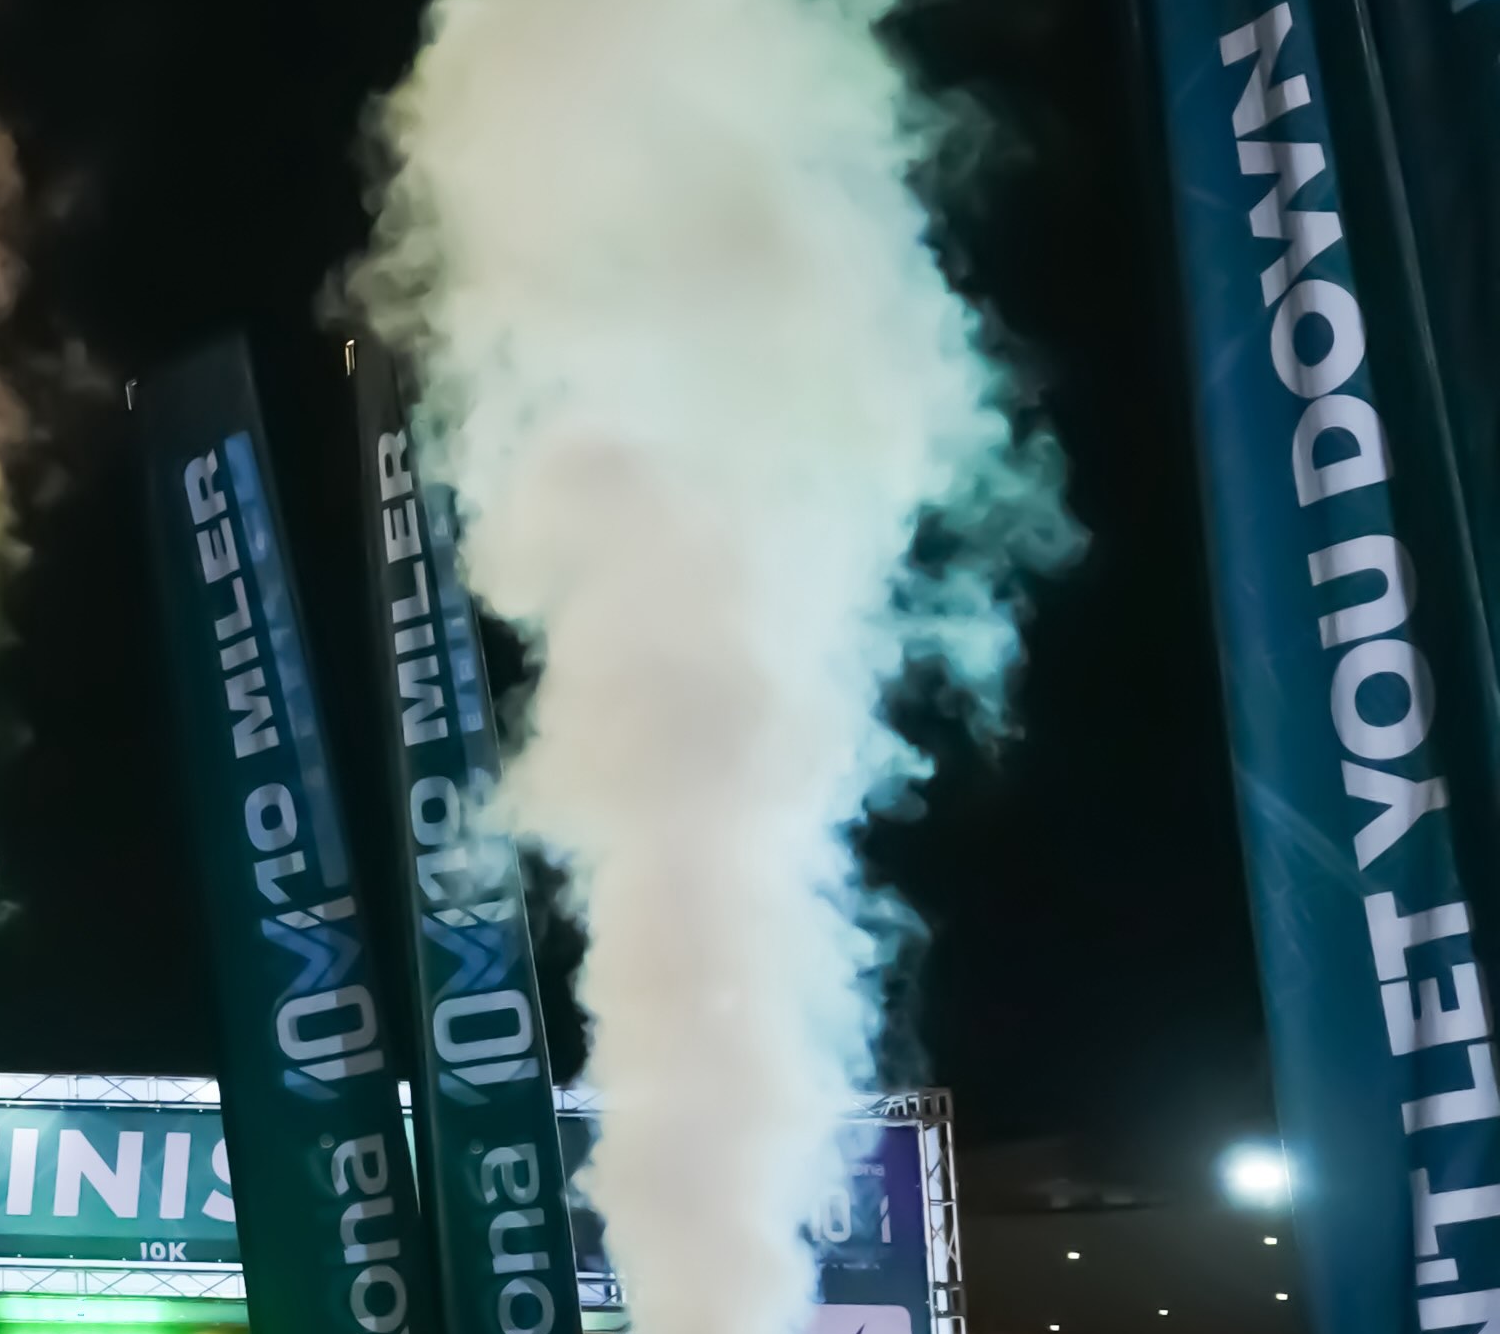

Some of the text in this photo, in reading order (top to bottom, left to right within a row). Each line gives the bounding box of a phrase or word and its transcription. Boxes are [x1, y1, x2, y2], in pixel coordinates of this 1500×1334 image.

[1218, 0, 1395, 509] DOWN
[183, 446, 281, 760] MILER
[376, 428, 449, 748] MILER
[1306, 533, 1451, 870] YOU
[243, 781, 307, 907] 10
[1365, 891, 1500, 1138] LET
[140, 1241, 188, 1262] 10K
